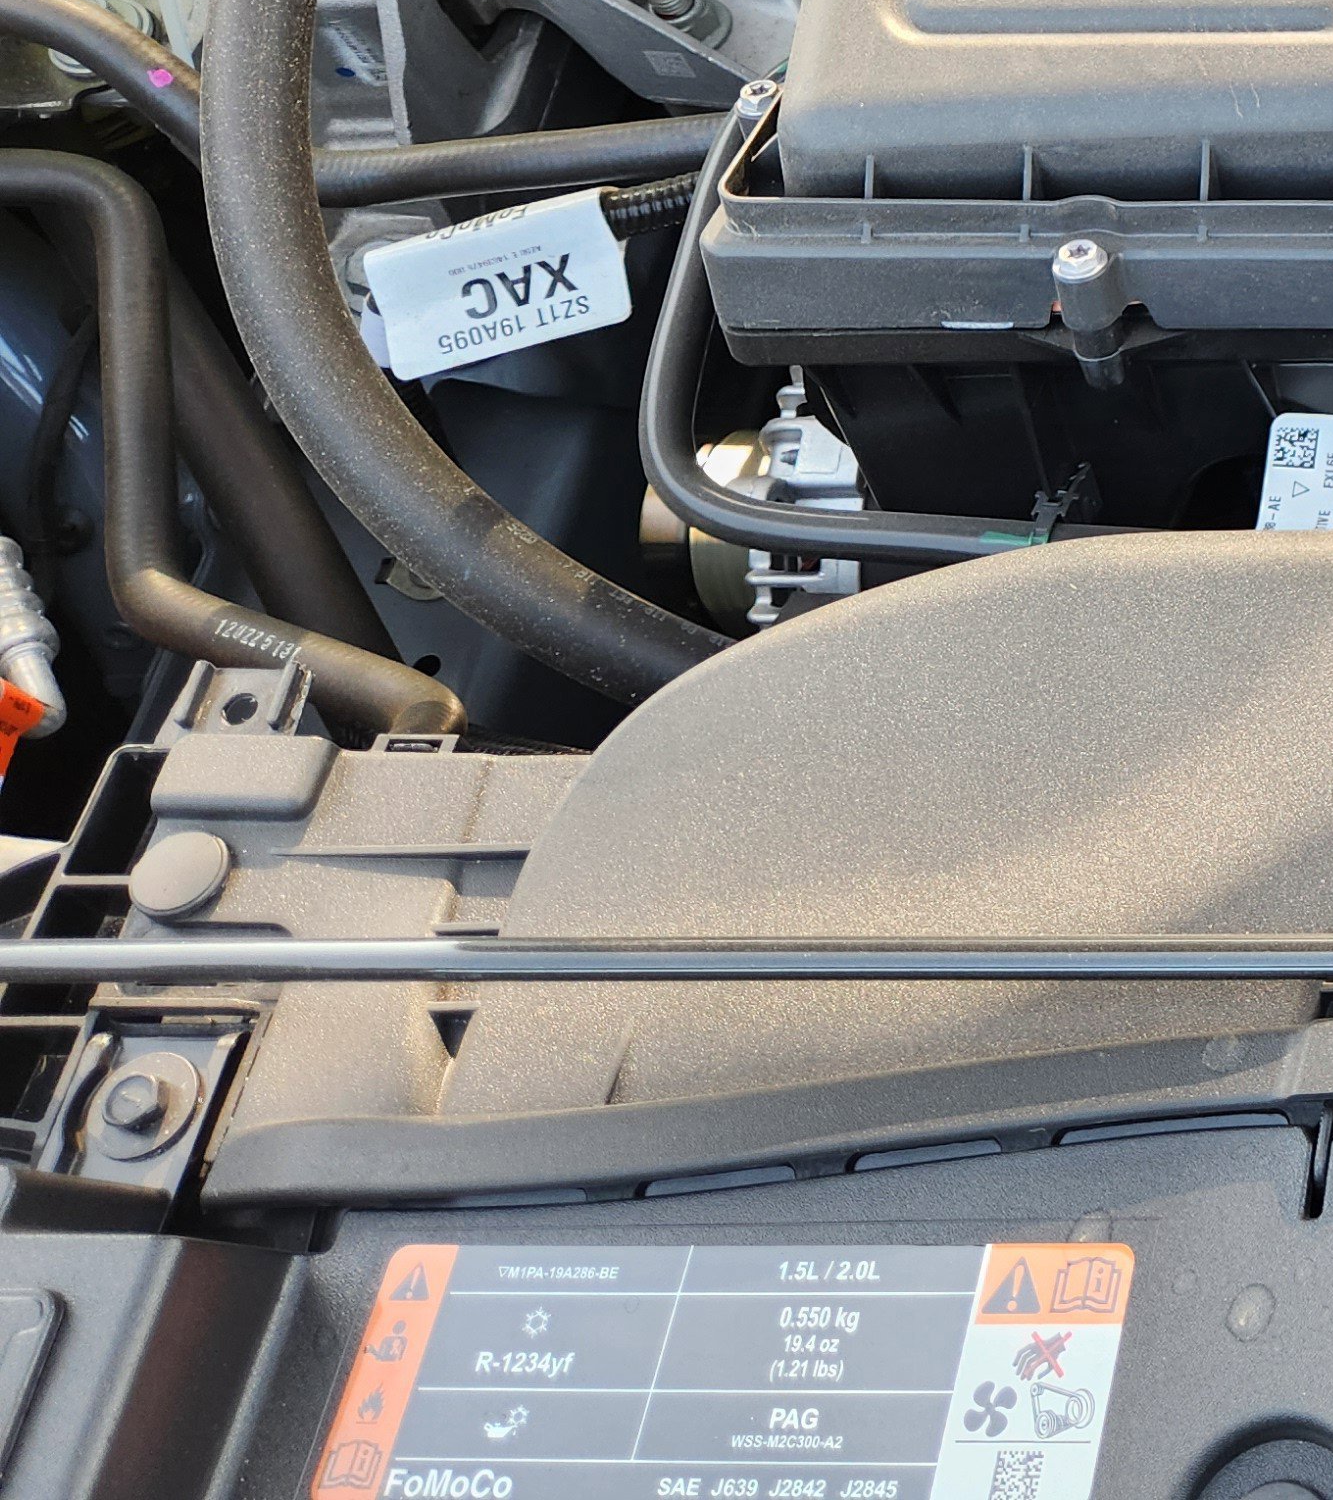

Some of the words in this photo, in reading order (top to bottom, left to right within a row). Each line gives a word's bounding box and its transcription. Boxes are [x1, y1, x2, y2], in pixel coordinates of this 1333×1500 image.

[461, 252, 578, 320] XAC
[536, 295, 590, 328] SZ1T
[437, 314, 527, 355] 19A095
[778, 1261, 819, 1280] 1.5L
[823, 1260, 835, 1281] /
[835, 1260, 881, 1280] 2.0L
[778, 1306, 831, 1329] 0.550
[835, 1306, 861, 1333] kg
[783, 1335, 815, 1353] 19.4
[819, 1337, 840, 1353] oz
[474, 1351, 576, 1378] R-1234yf
[768, 1359, 808, 1383] (1.21
[811, 1359, 845, 1383] lbs)
[768, 1407, 819, 1430] PAG
[730, 1434, 843, 1450] WSS-M2C300-A2
[382, 1467, 513, 1499] FoMoCo
[656, 1476, 702, 1498] SAE
[711, 1477, 760, 1498] J639
[767, 1477, 828, 1499] J2842
[839, 1478, 899, 1499] J2845
